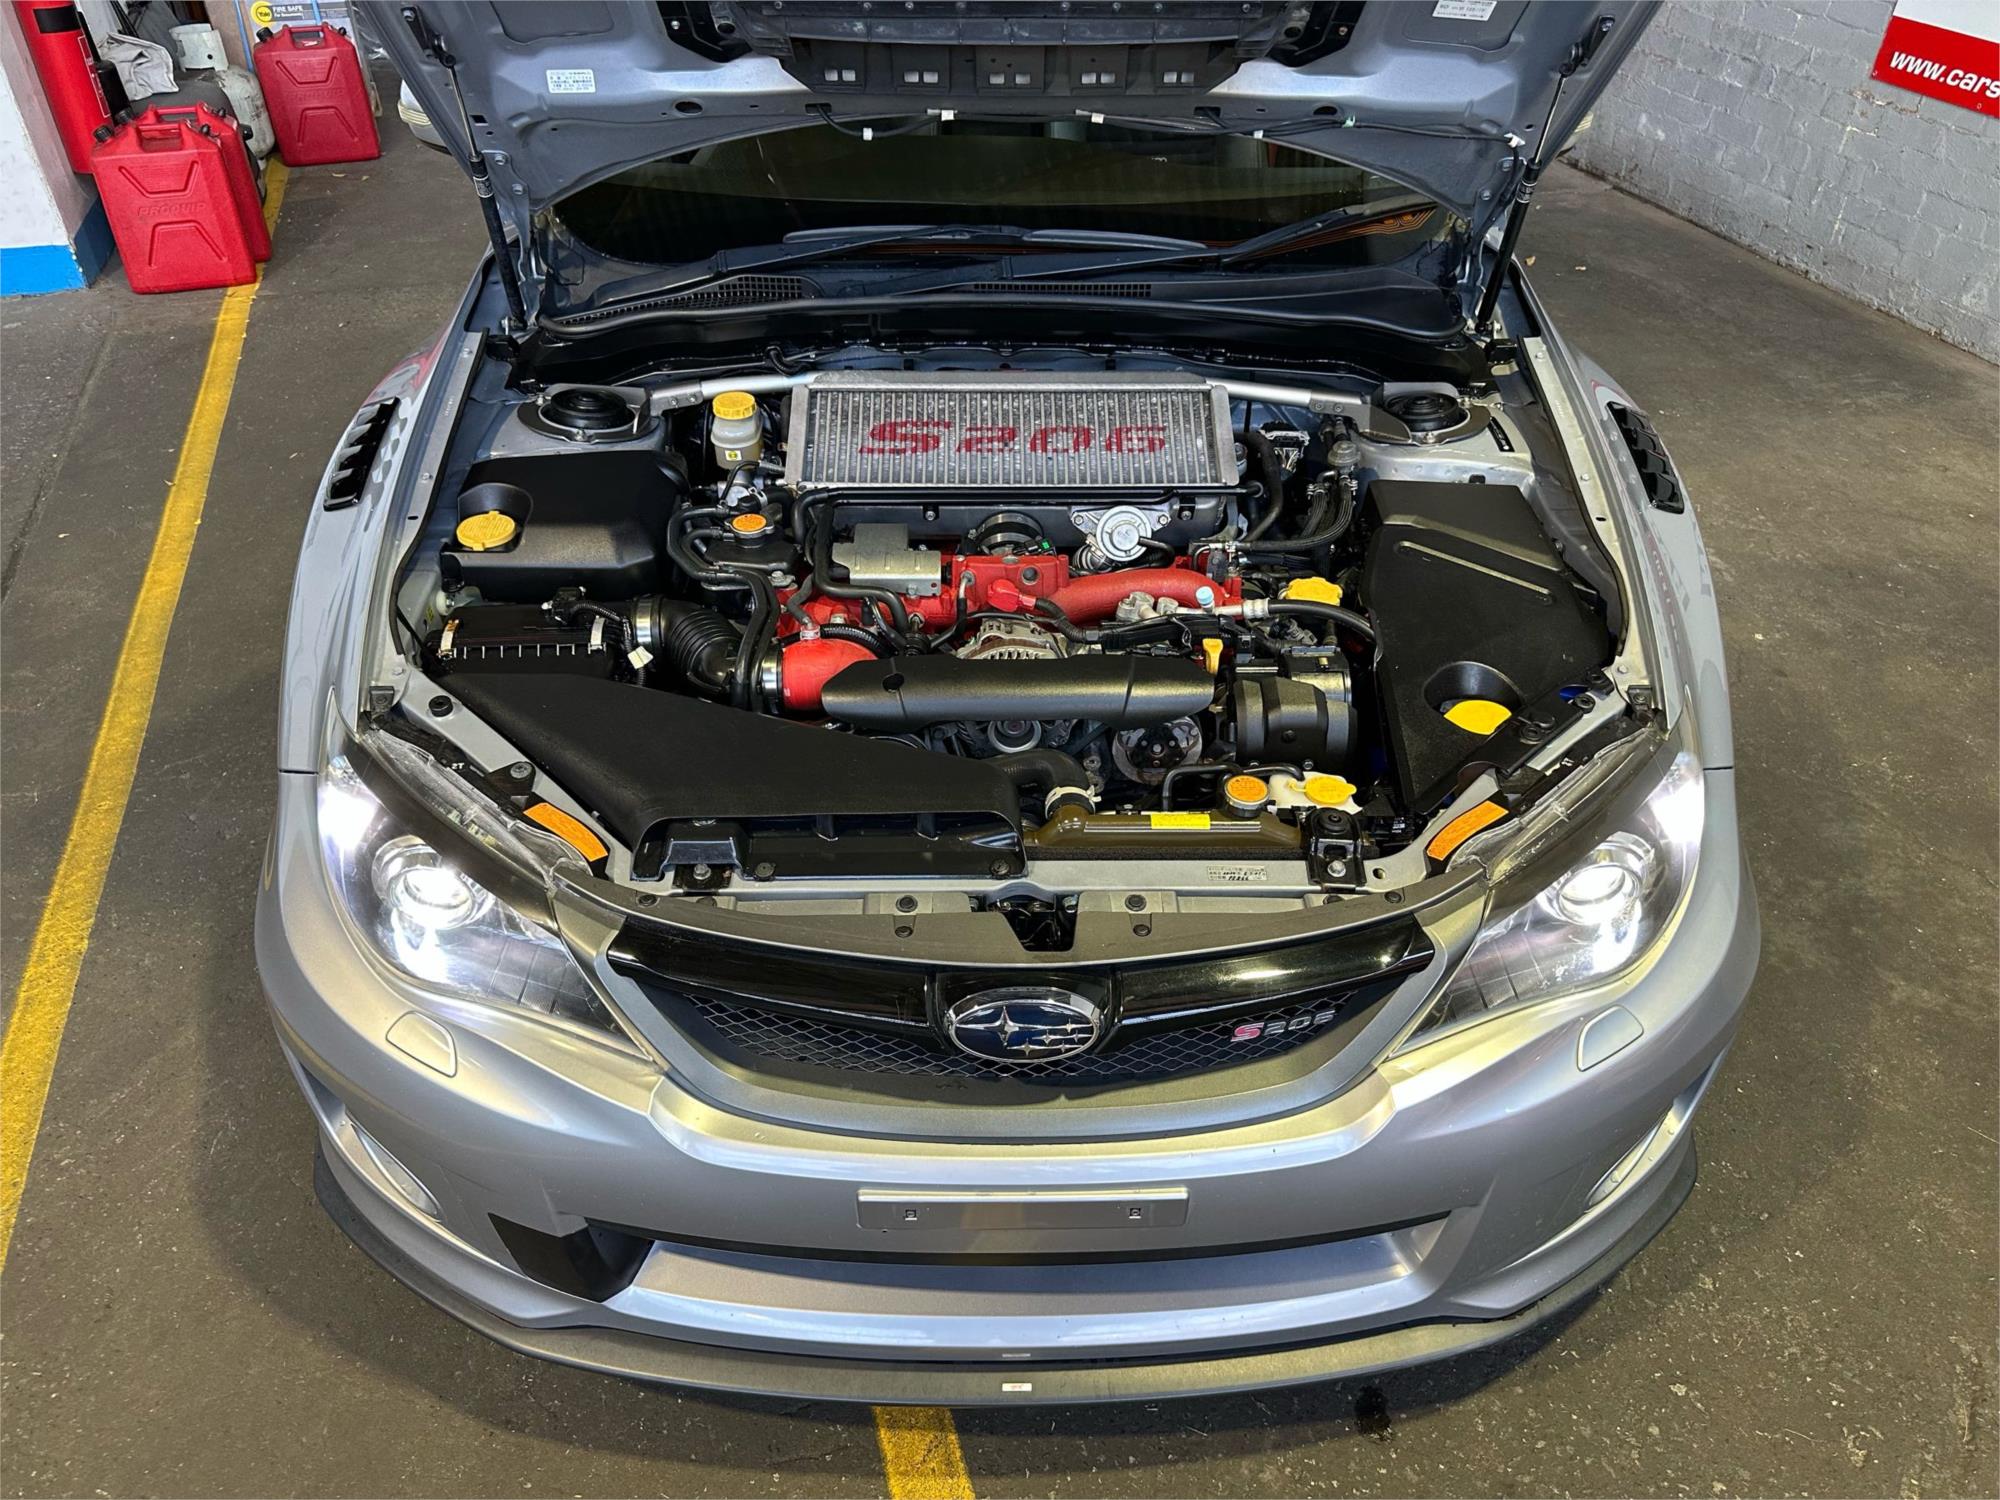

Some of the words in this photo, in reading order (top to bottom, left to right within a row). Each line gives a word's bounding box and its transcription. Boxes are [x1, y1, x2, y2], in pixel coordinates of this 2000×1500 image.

[138, 202, 207, 216] PROQUIP
[858, 420, 1167, 454] S206
[1231, 1010, 1336, 1042] S206
